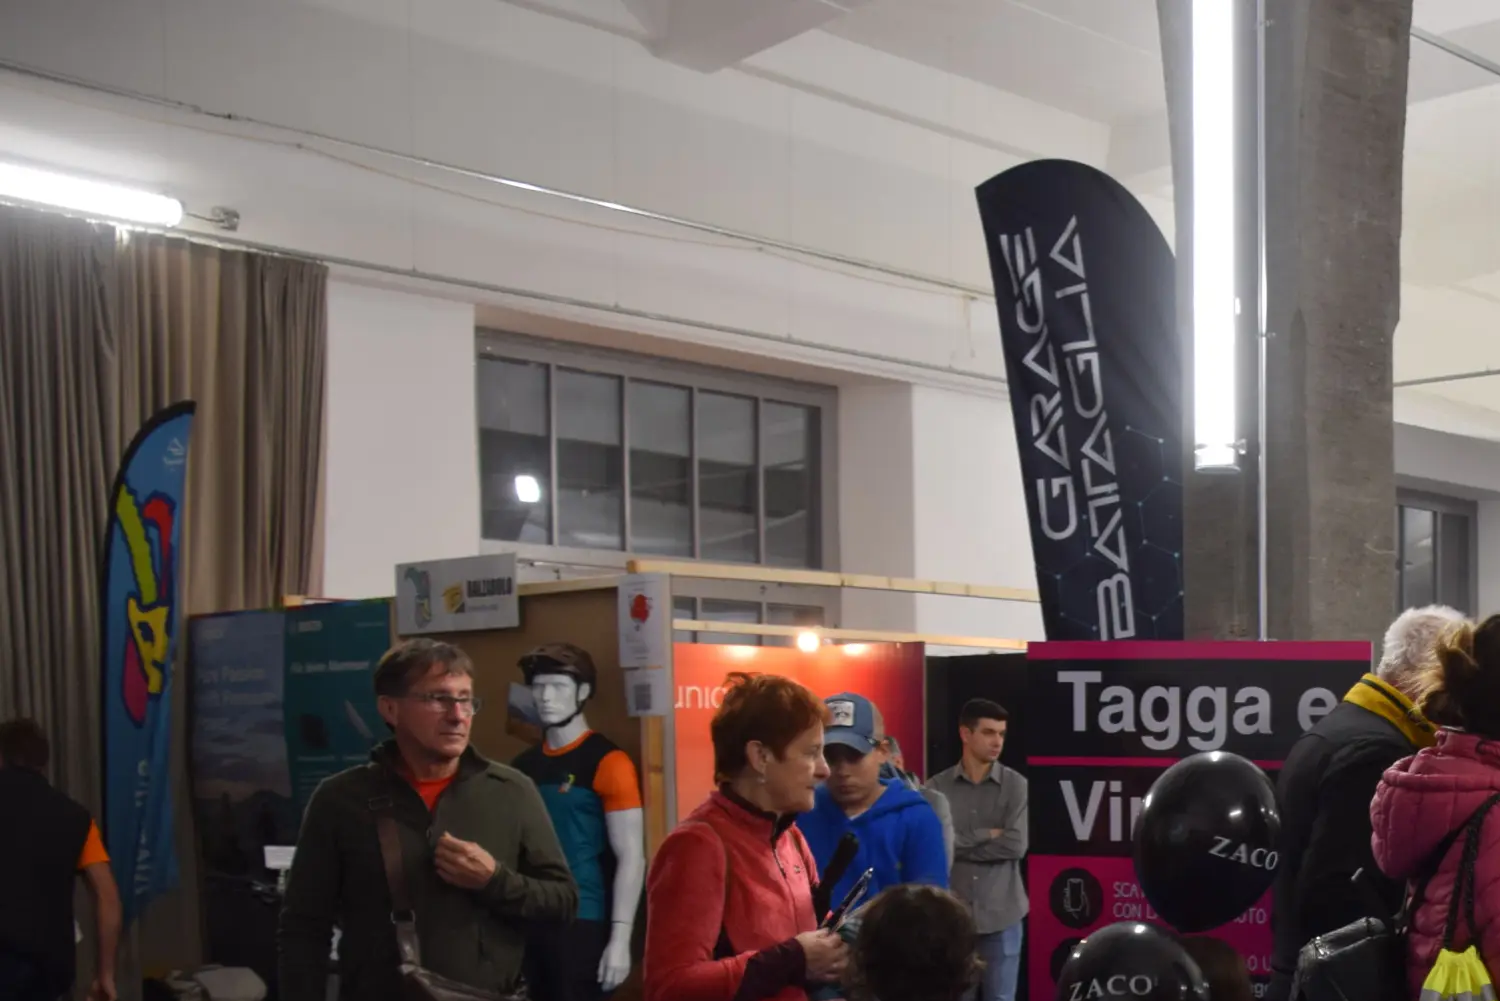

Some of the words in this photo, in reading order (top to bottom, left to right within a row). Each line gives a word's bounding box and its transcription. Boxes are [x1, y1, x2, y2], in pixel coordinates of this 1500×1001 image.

[1000, 226, 1078, 541] GARAGE
[1057, 670, 1273, 751] Tagga
[1297, 686, 1338, 732] e
[1208, 835, 1279, 871] ZACO
[1112, 902, 1142, 919] CON
